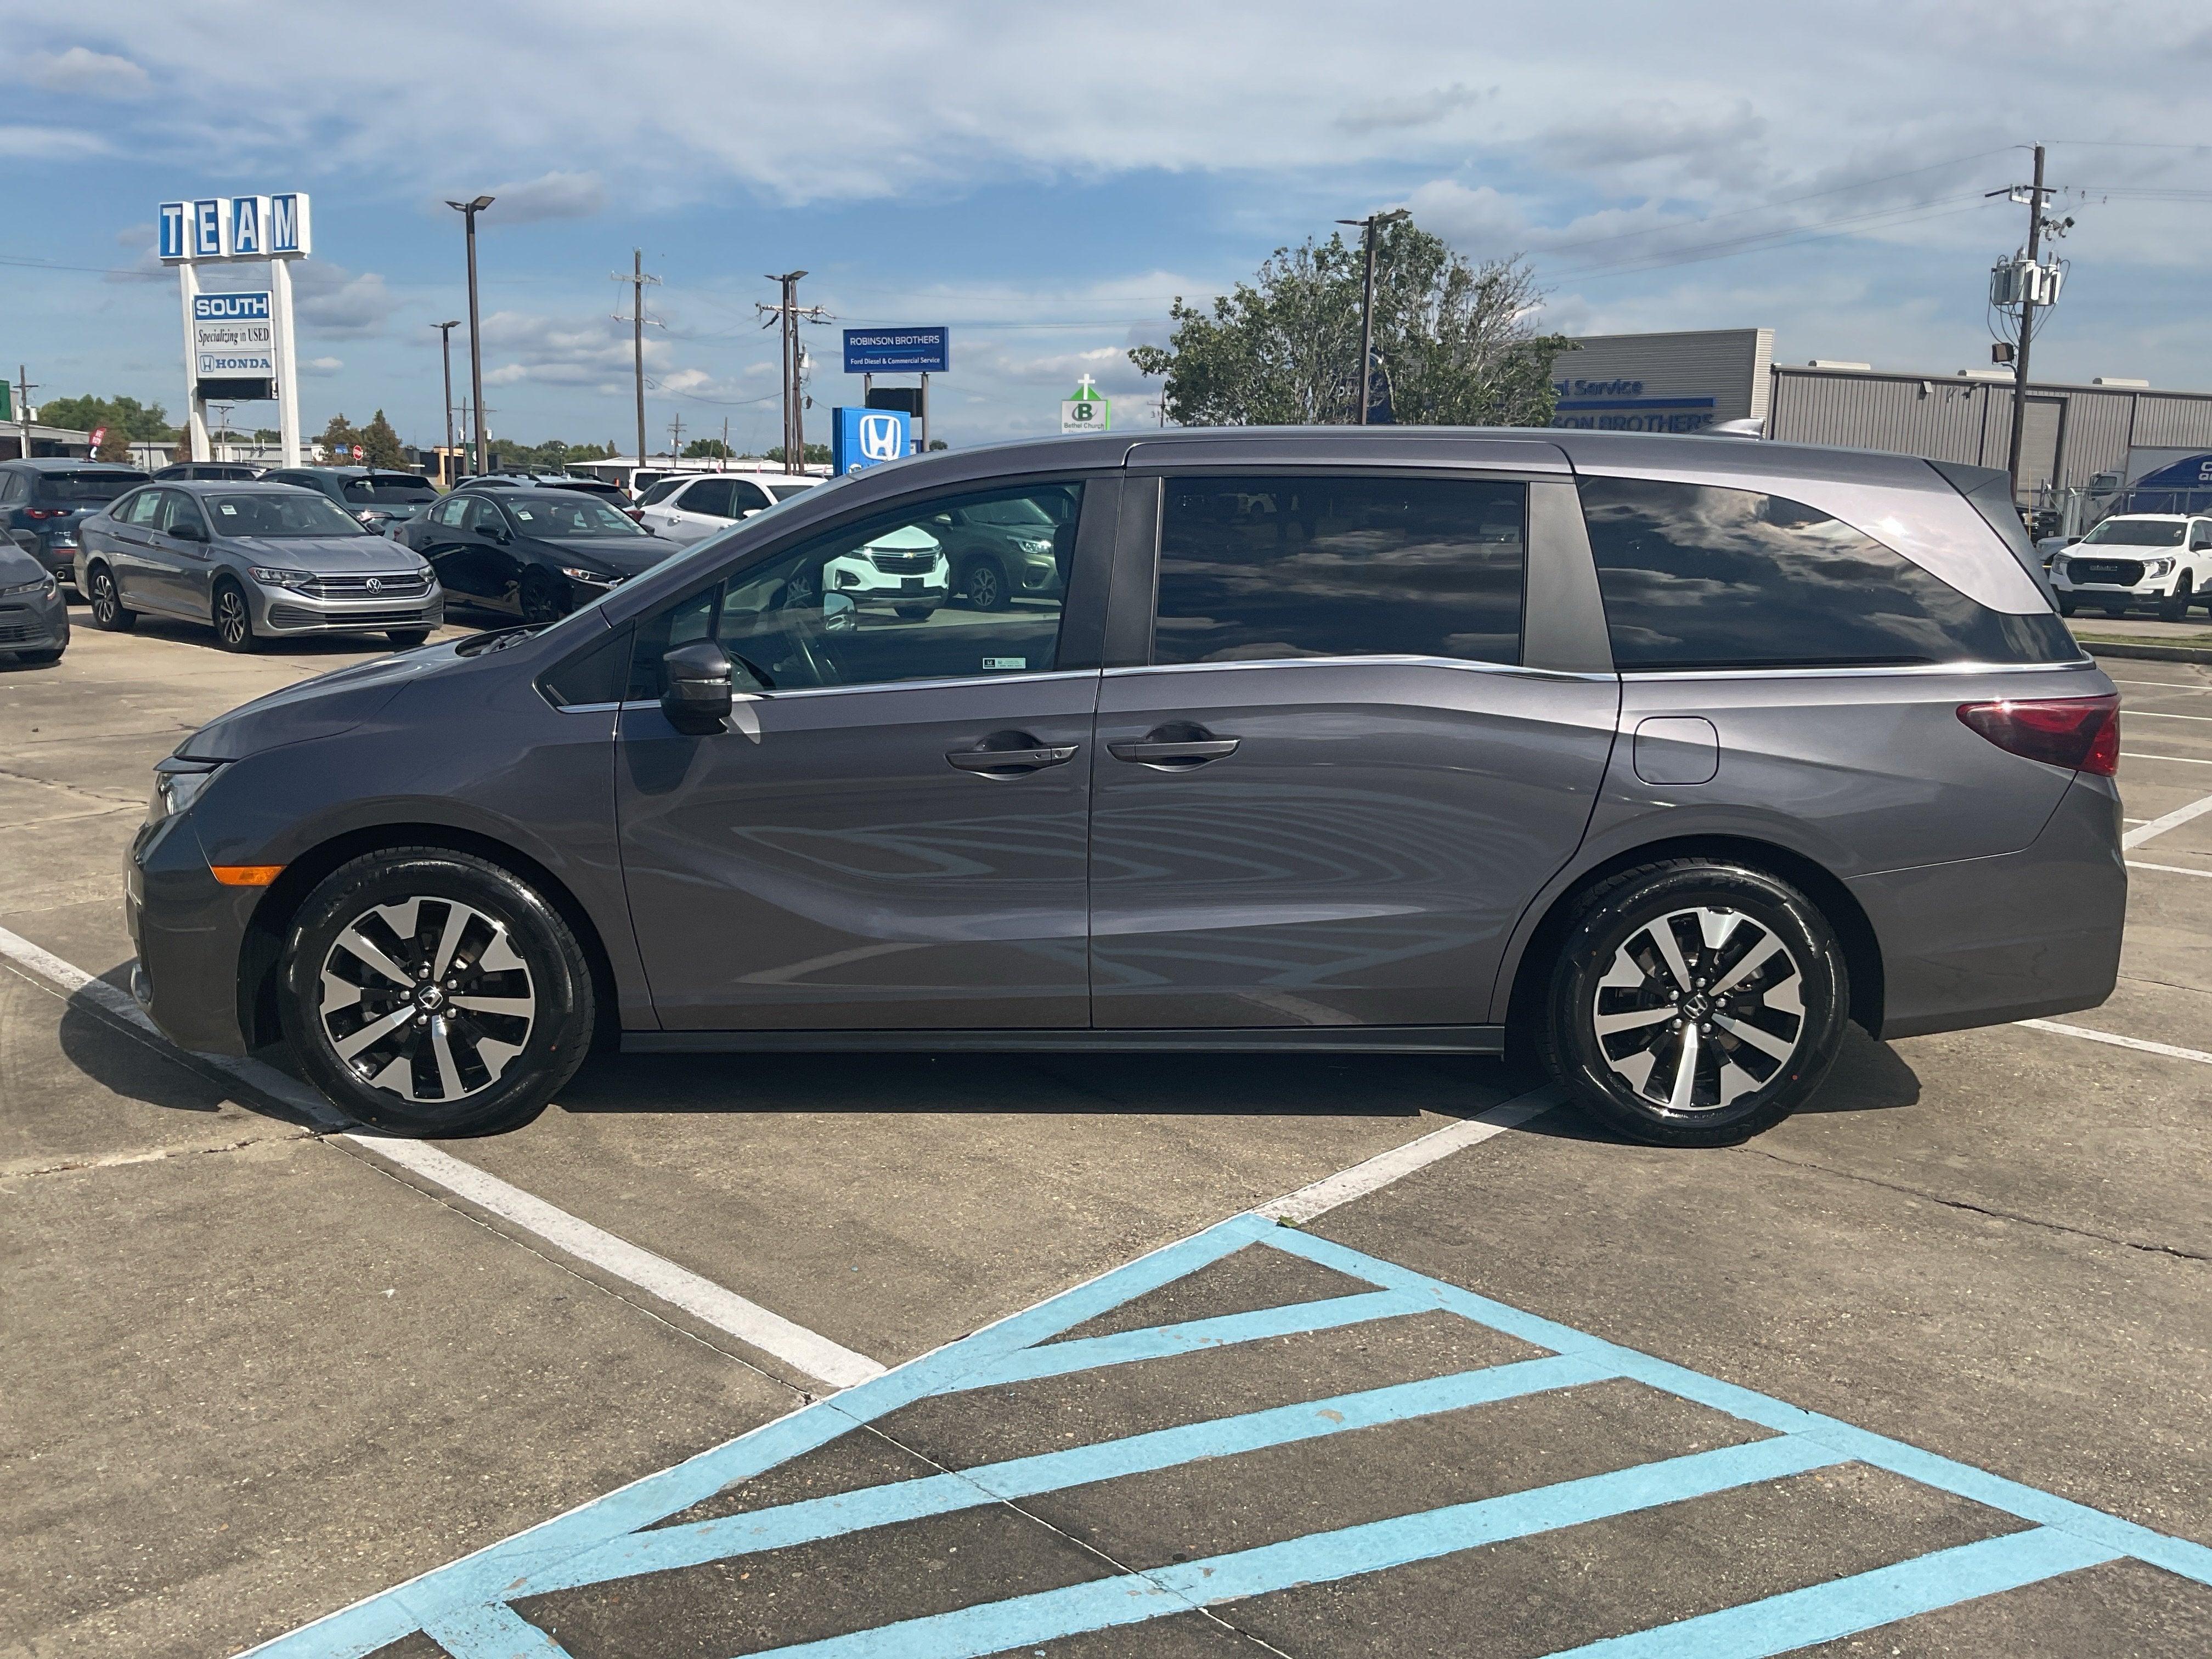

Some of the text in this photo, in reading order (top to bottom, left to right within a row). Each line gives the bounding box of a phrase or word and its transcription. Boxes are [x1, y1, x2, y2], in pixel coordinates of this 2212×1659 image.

[162, 198, 297, 253] TEAM
[196, 297, 268, 316] SOUTH
[198, 328, 269, 346] Specializing in USED
[850, 335, 940, 346] ROBINSON BROTHERS
[215, 358, 270, 369] HONDA
[1574, 379, 1643, 396] Service
[1084, 422, 1104, 431] Church
